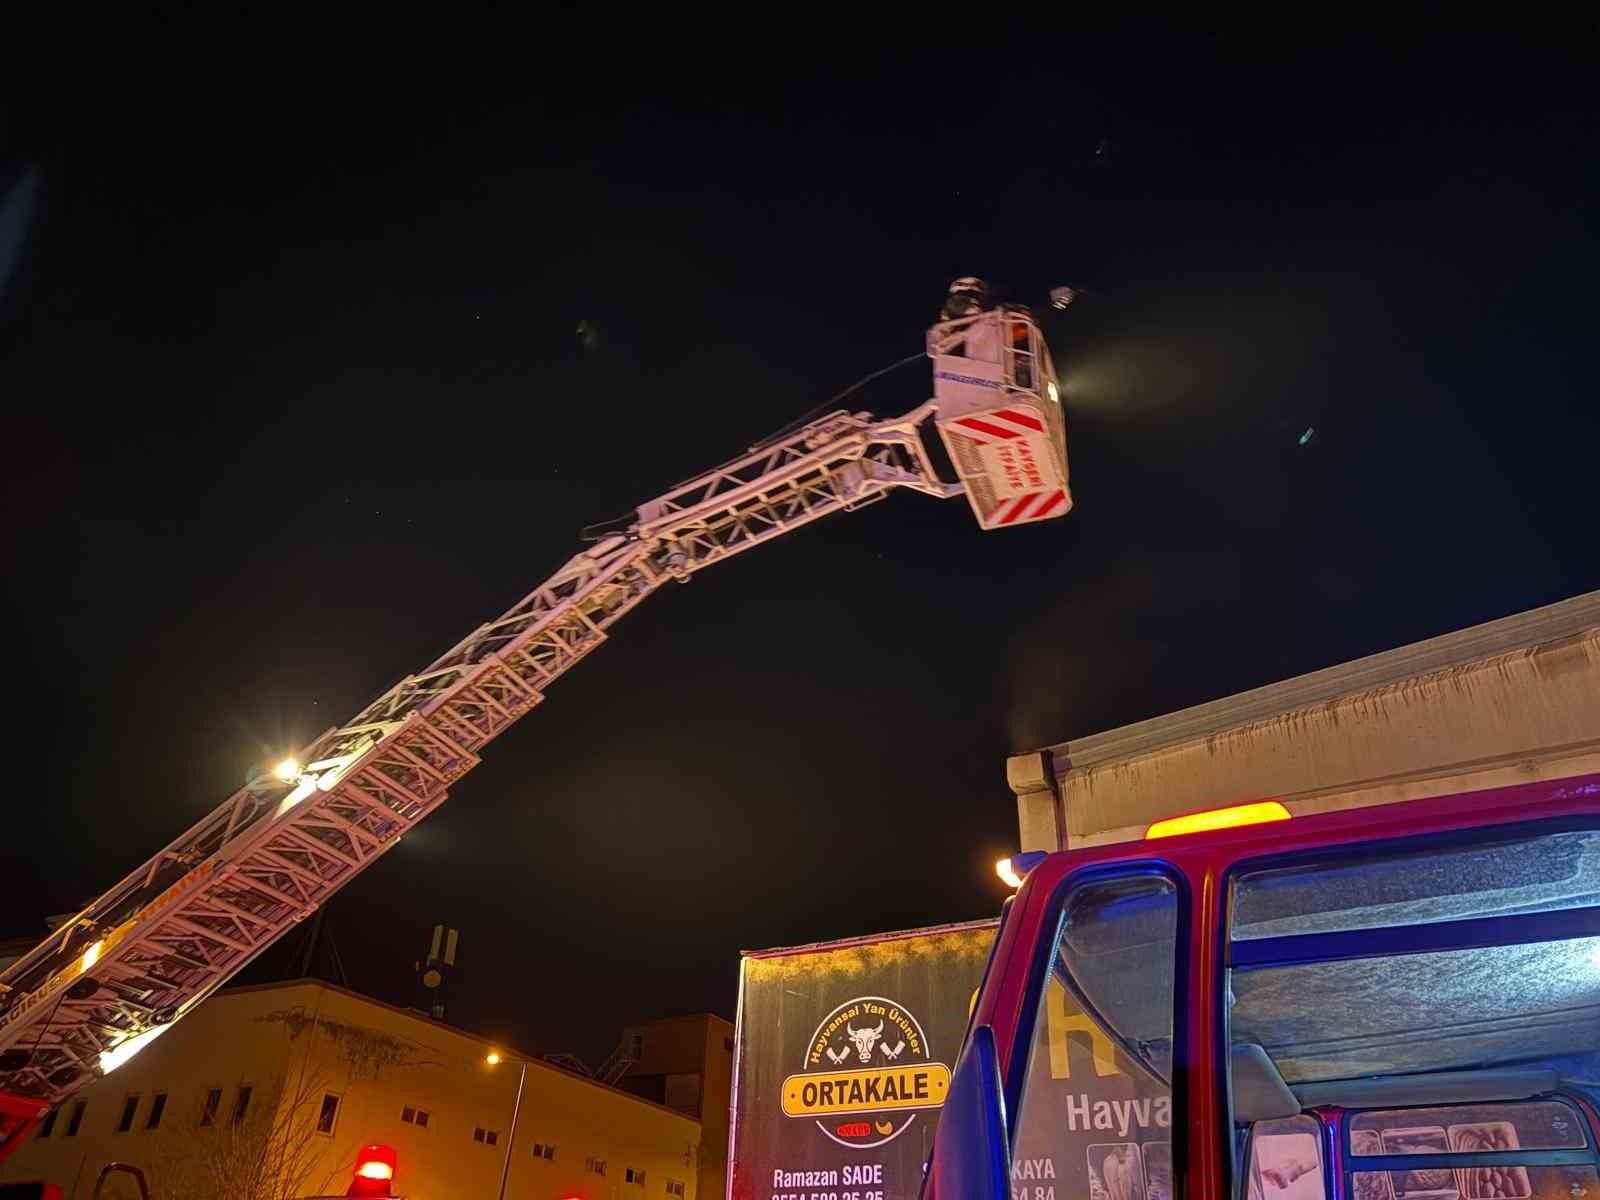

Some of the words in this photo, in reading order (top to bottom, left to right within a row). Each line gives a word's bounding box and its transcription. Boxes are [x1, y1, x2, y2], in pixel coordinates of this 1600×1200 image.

[810, 1005, 860, 1064] Hayvansal
[863, 1002, 886, 1016] Yan
[889, 1008, 921, 1055] Ürünler
[802, 1073, 929, 1108] ORTAKALE
[1066, 1094, 1170, 1137] Hayva
[773, 1169, 838, 1188] Ramazan
[842, 1165, 882, 1185] SADE
